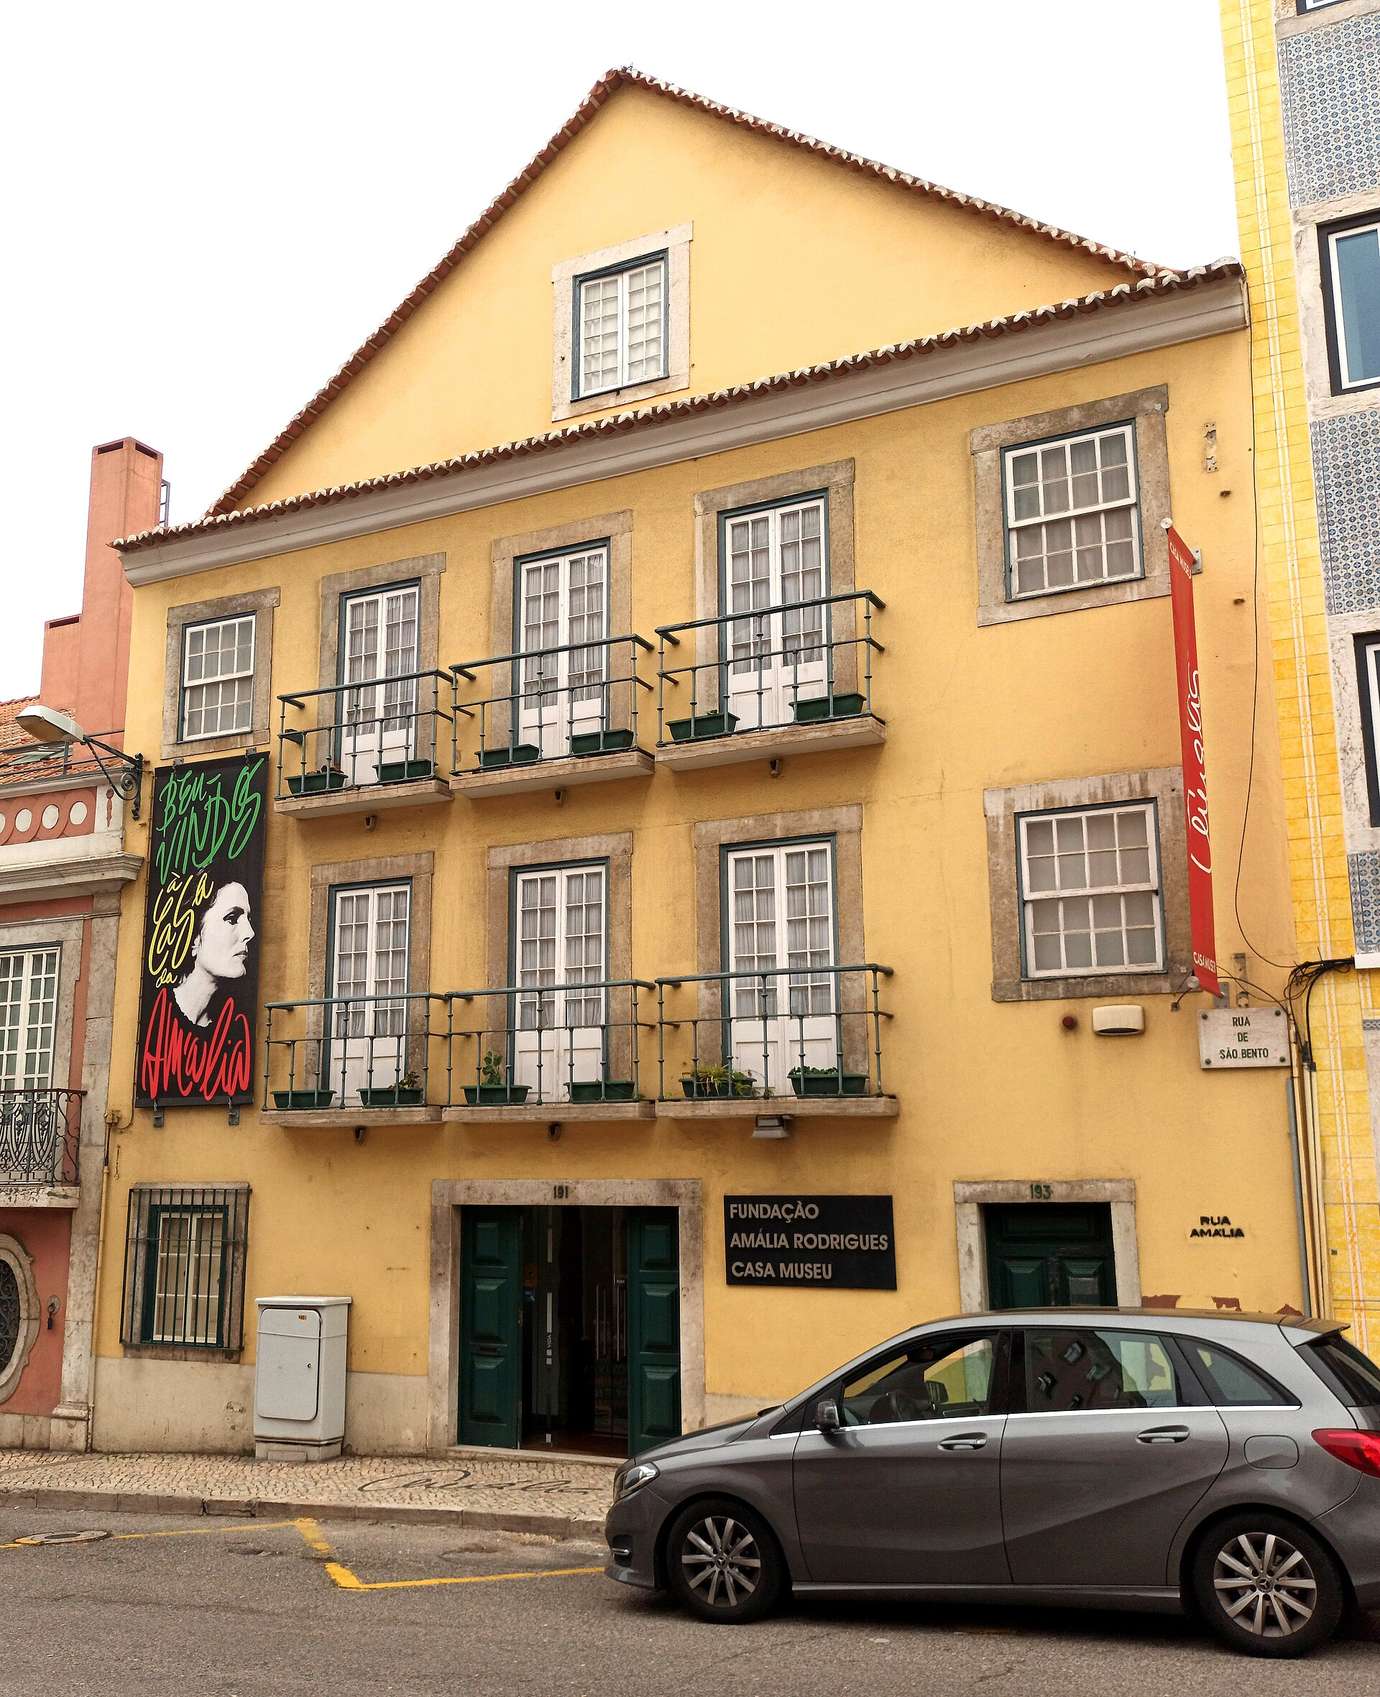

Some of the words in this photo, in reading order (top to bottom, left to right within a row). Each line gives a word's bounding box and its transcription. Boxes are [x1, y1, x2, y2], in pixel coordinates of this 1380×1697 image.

[1232, 1016, 1251, 1027] RUA
[1237, 1032, 1249, 1042] DE
[1219, 1047, 1238, 1060] SÃO
[1241, 1047, 1269, 1059] BENTO
[553, 1184, 569, 1199] 191
[1030, 1184, 1051, 1200] 193
[729, 1201, 820, 1223] FUNDAÇÃO
[1199, 1216, 1231, 1226] RUA
[730, 1228, 790, 1249] AMÁLIA
[793, 1233, 889, 1251] RODRIGUES
[731, 1261, 776, 1278] CASA
[779, 1263, 833, 1280] MUSEU
